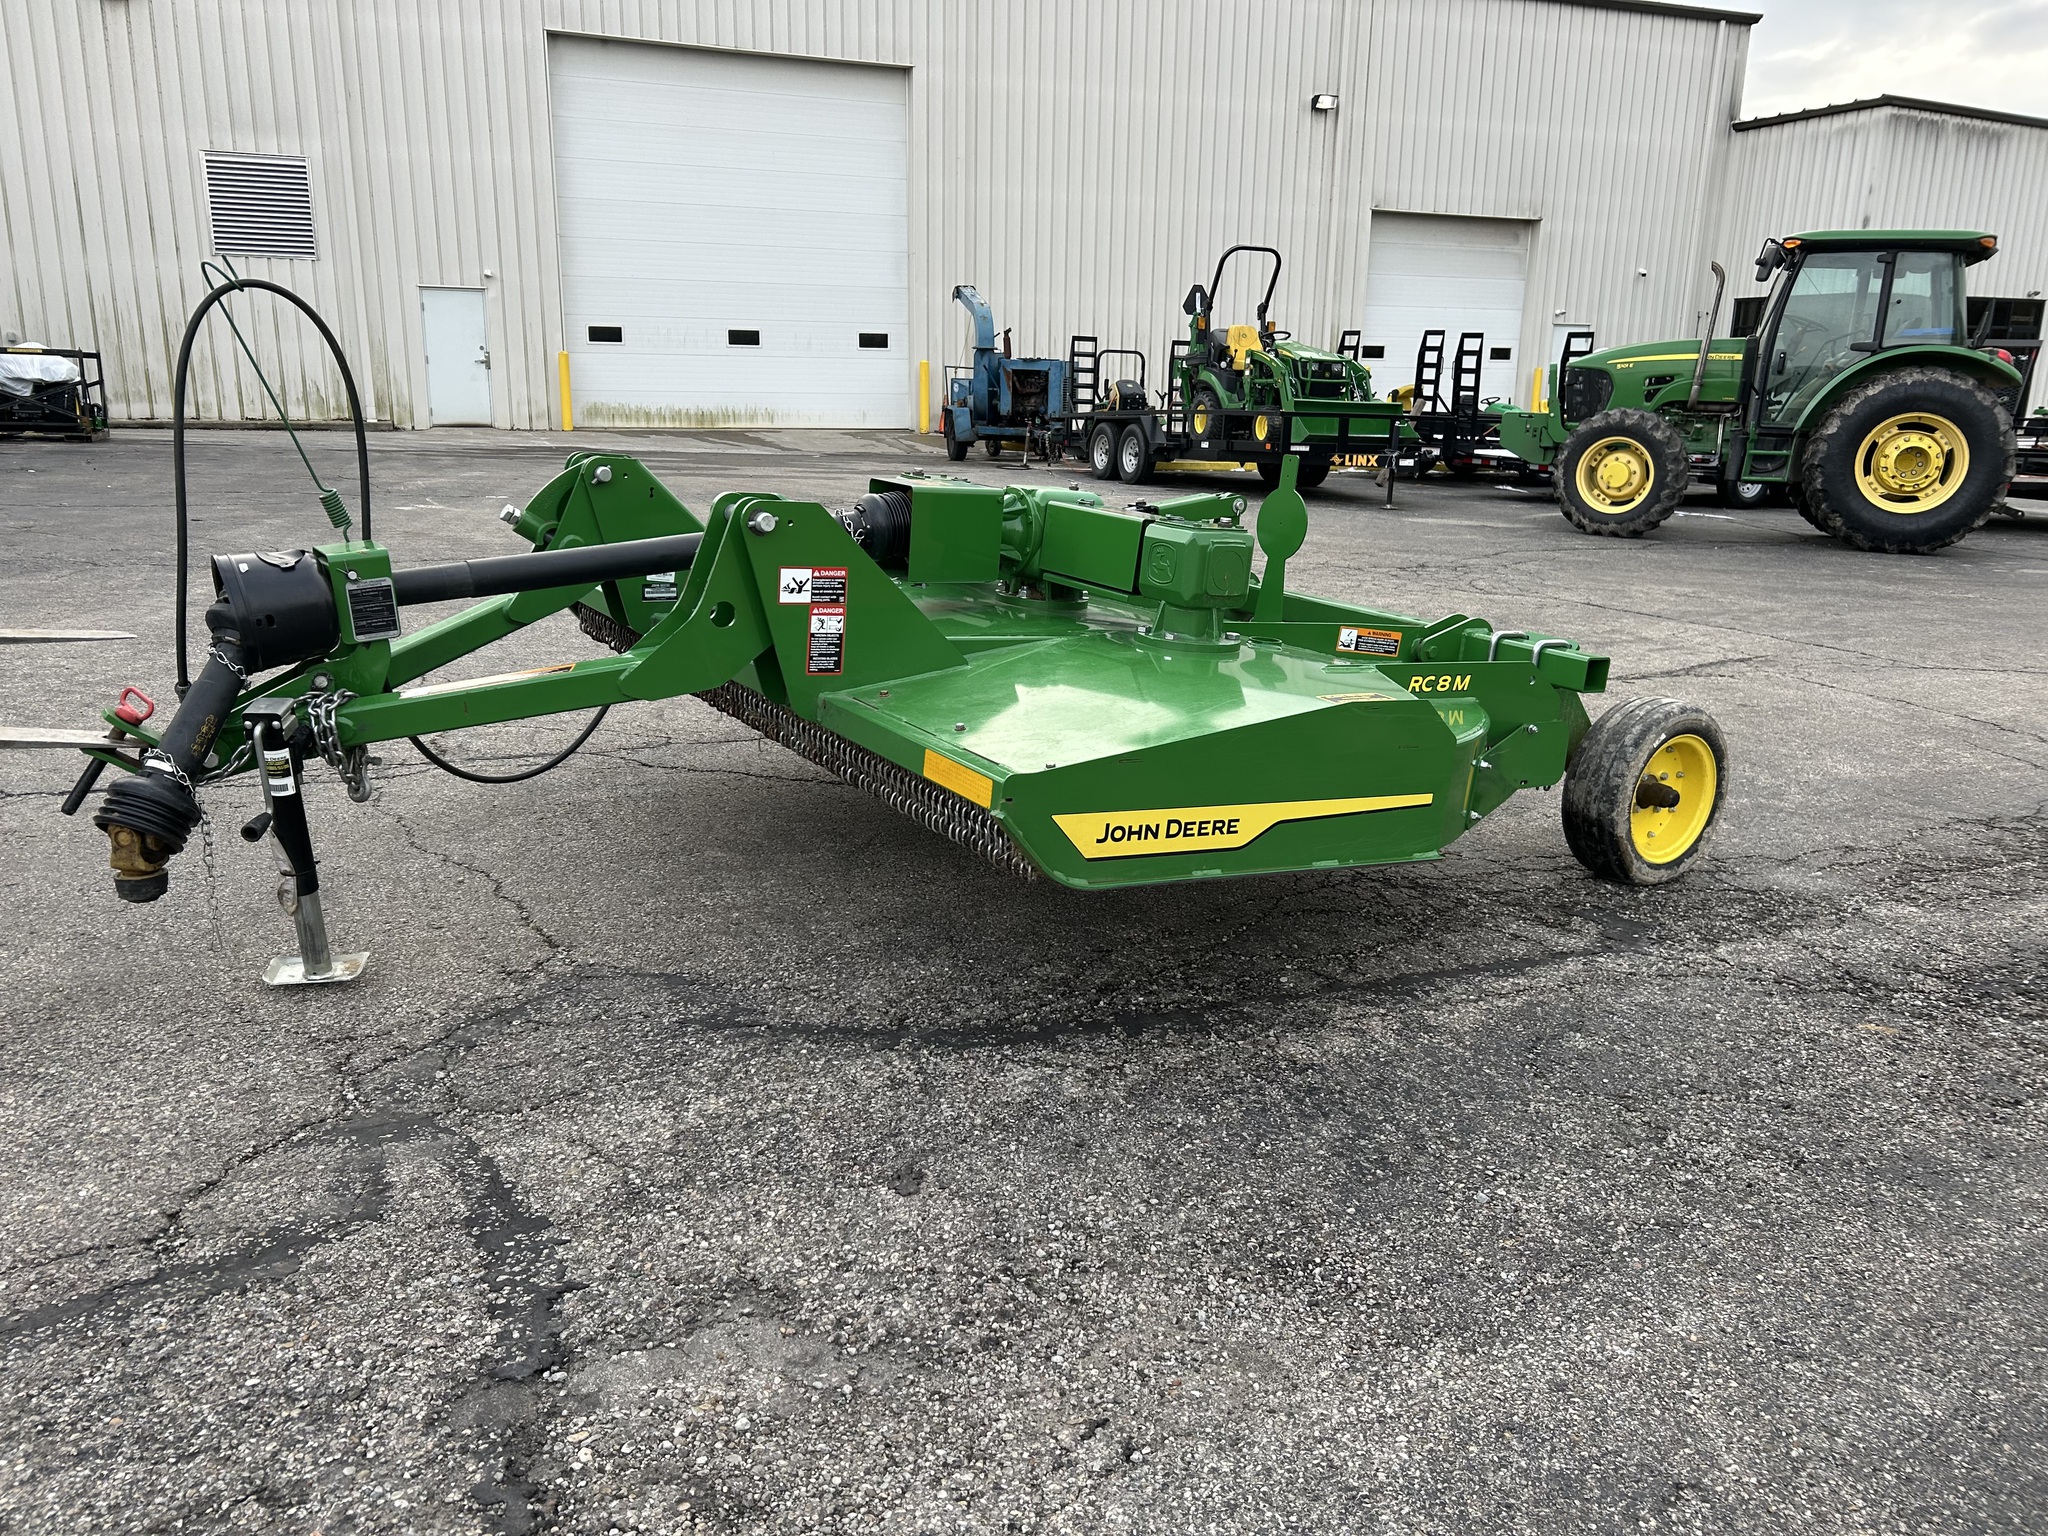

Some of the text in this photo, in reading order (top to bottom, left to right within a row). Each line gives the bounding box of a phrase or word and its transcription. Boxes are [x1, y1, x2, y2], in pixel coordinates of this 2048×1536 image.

[1344, 454, 1378, 467] LINX
[1095, 818, 1240, 844] JOHN DEERE
